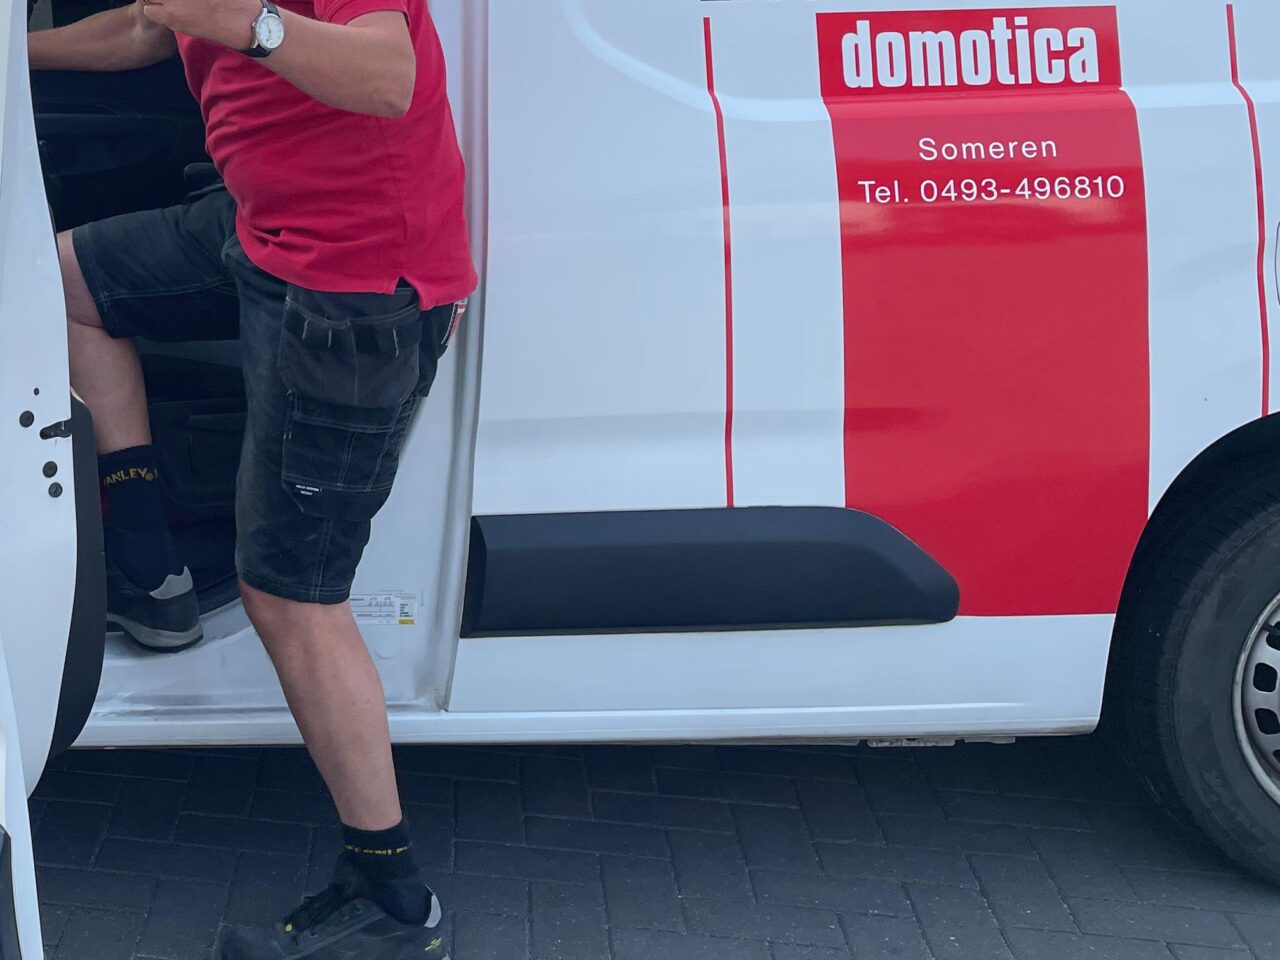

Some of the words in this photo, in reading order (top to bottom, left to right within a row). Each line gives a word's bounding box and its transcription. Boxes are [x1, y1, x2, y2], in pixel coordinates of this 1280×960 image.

[841, 16, 1100, 89] domotica
[918, 137, 1057, 161] Someren
[857, 180, 909, 204] Tel.
[920, 175, 1124, 203] 0493-496810
